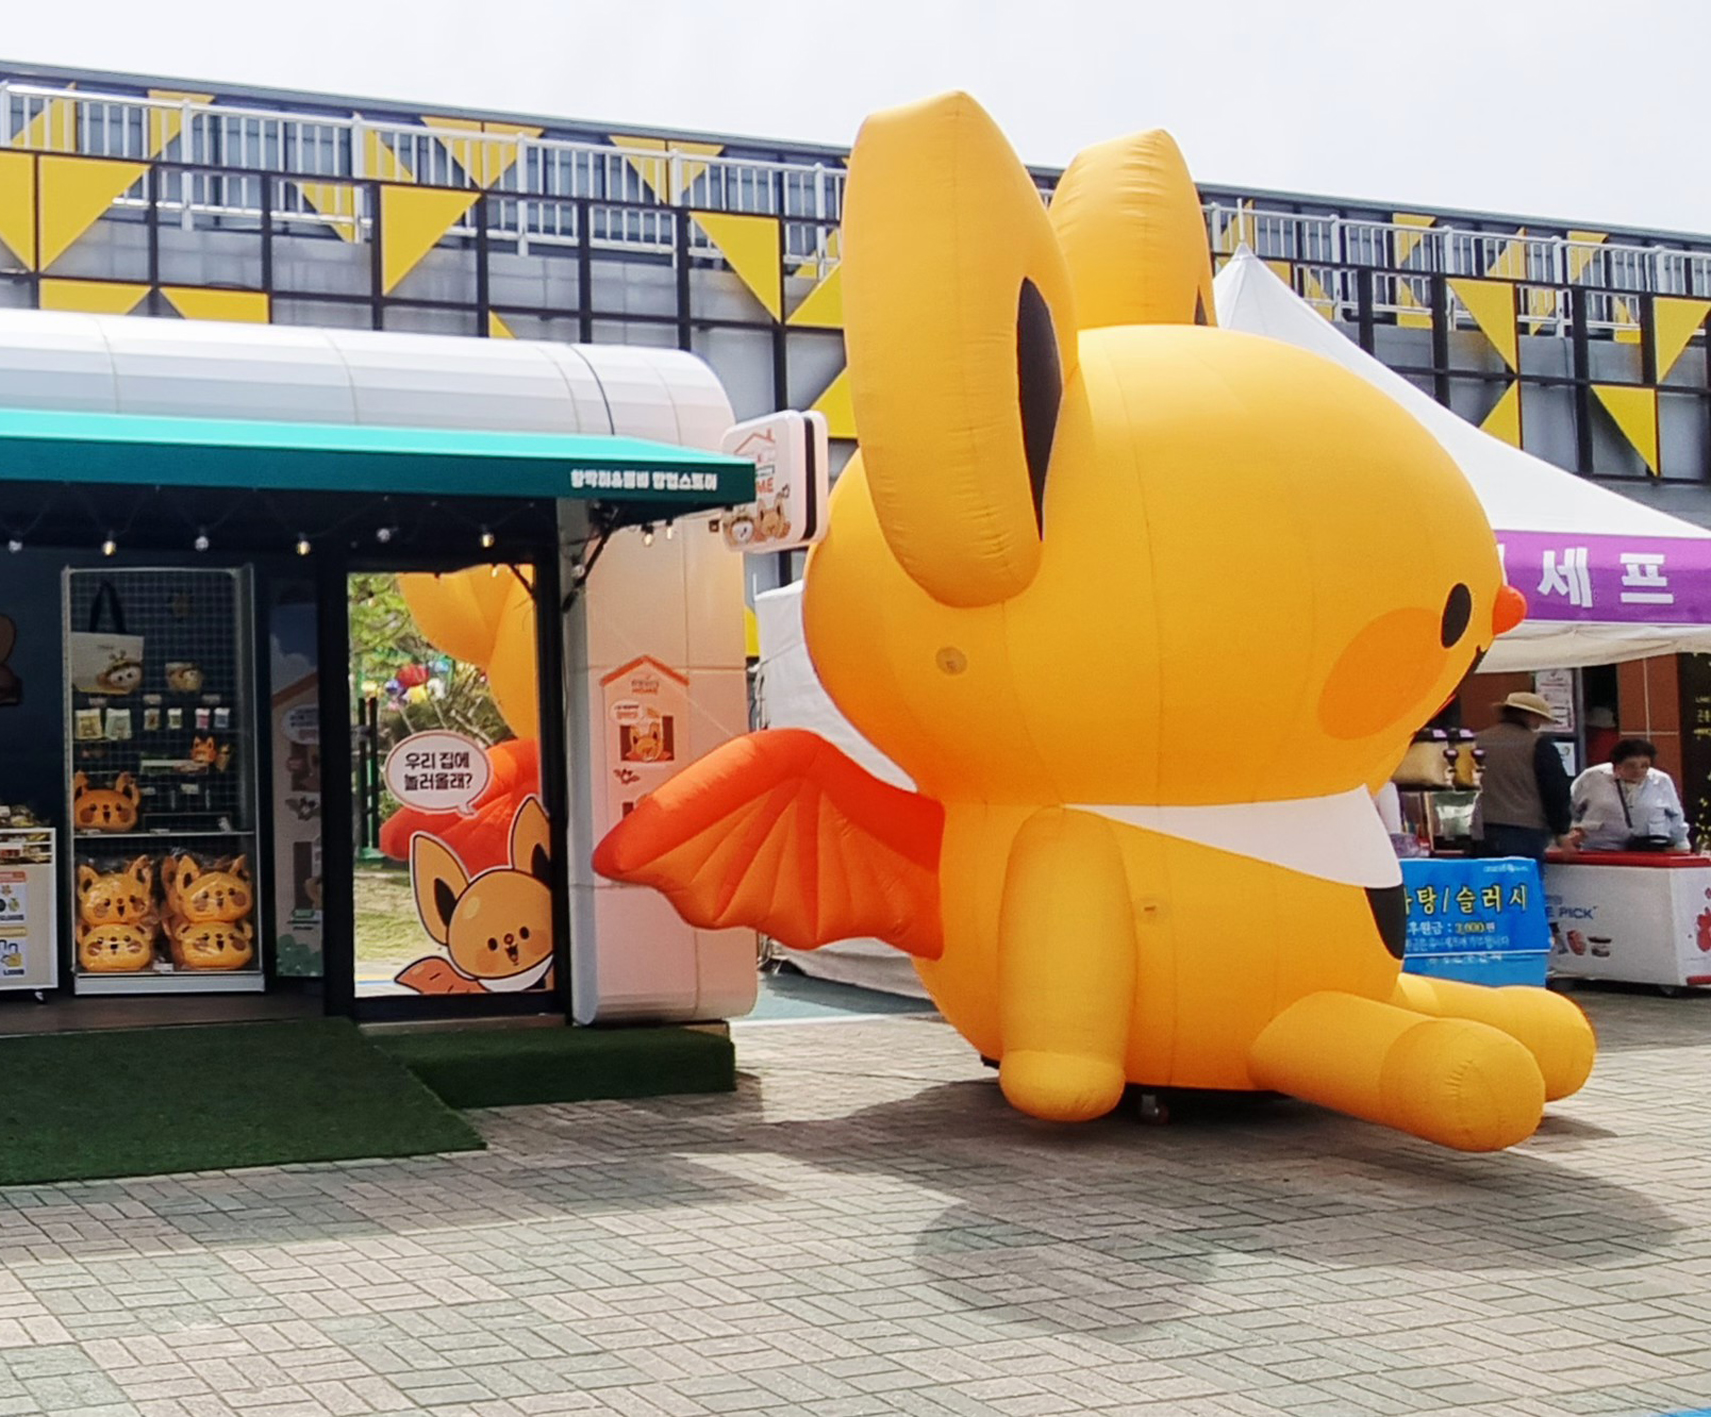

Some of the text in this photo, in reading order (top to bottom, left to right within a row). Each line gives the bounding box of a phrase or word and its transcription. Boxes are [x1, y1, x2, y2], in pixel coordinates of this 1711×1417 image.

[1496, 543, 1675, 608] 세프
[405, 751, 470, 770] 우리 집에
[404, 772, 474, 792] 놀러올래?
[1558, 906, 1594, 920] PICK
[1407, 921, 1443, 936] 후원금
